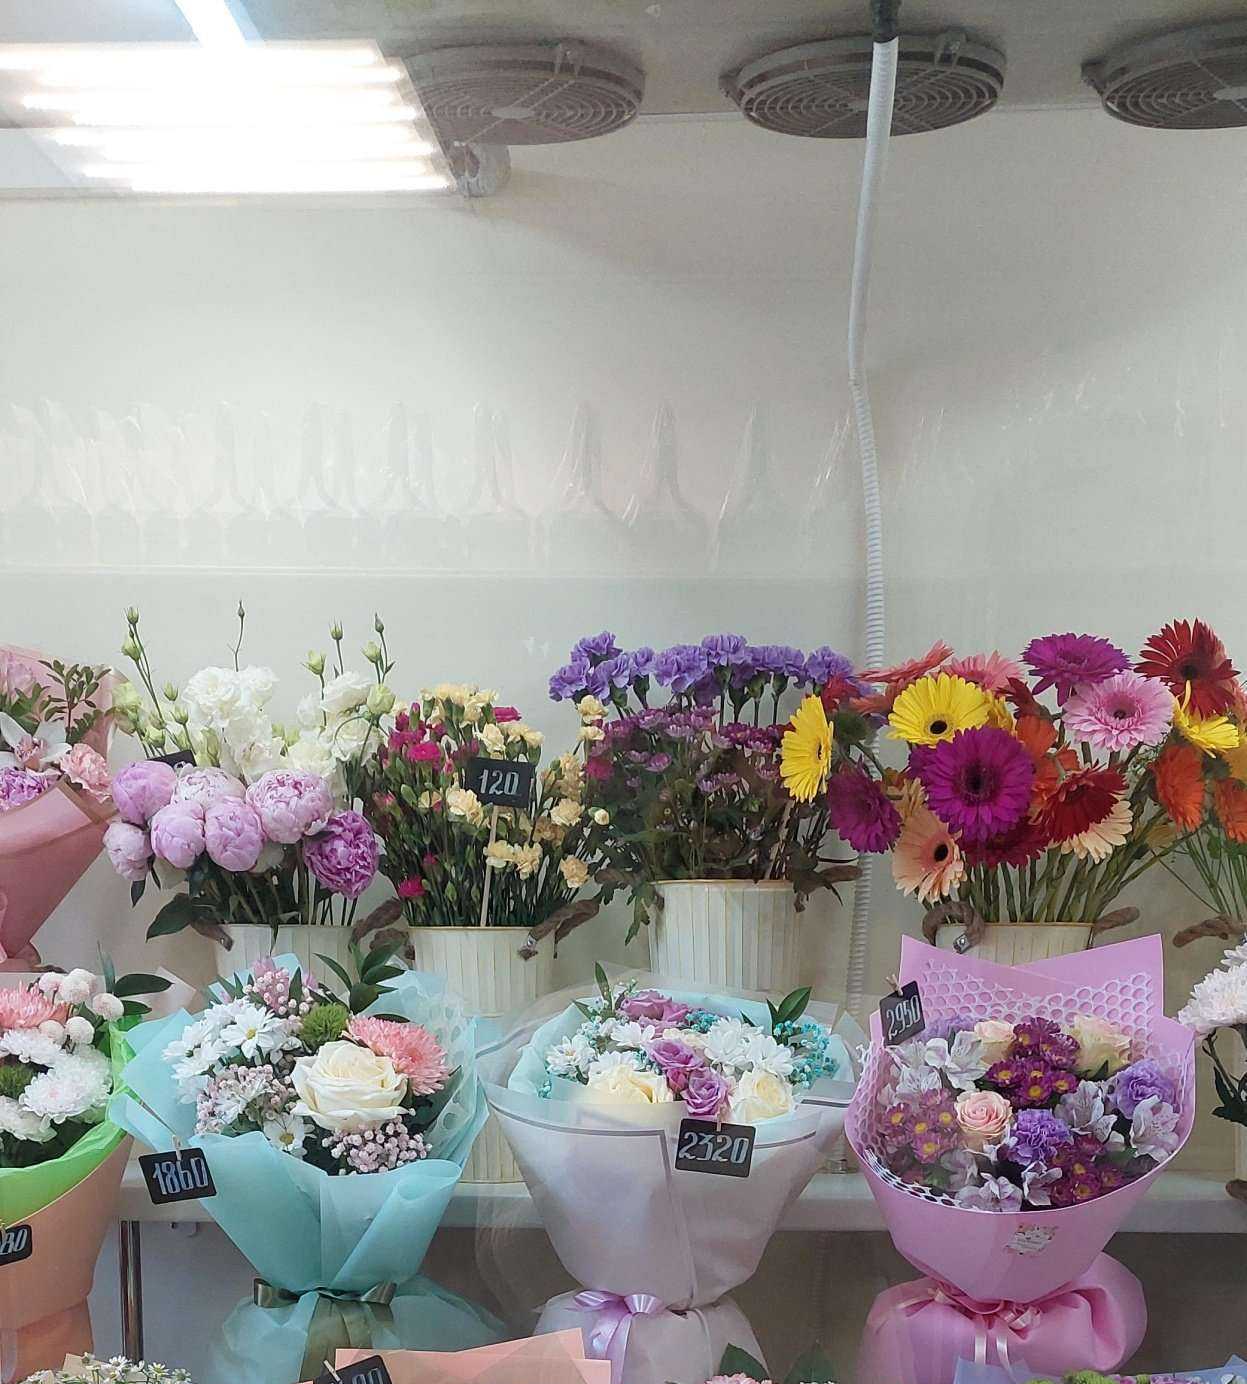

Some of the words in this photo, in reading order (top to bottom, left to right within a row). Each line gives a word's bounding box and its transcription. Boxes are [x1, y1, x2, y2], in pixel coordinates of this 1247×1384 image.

[479, 768, 520, 796] 120
[886, 995, 921, 1040] 2950
[679, 1132, 750, 1163] 2320
[152, 1157, 209, 1195] 1860
